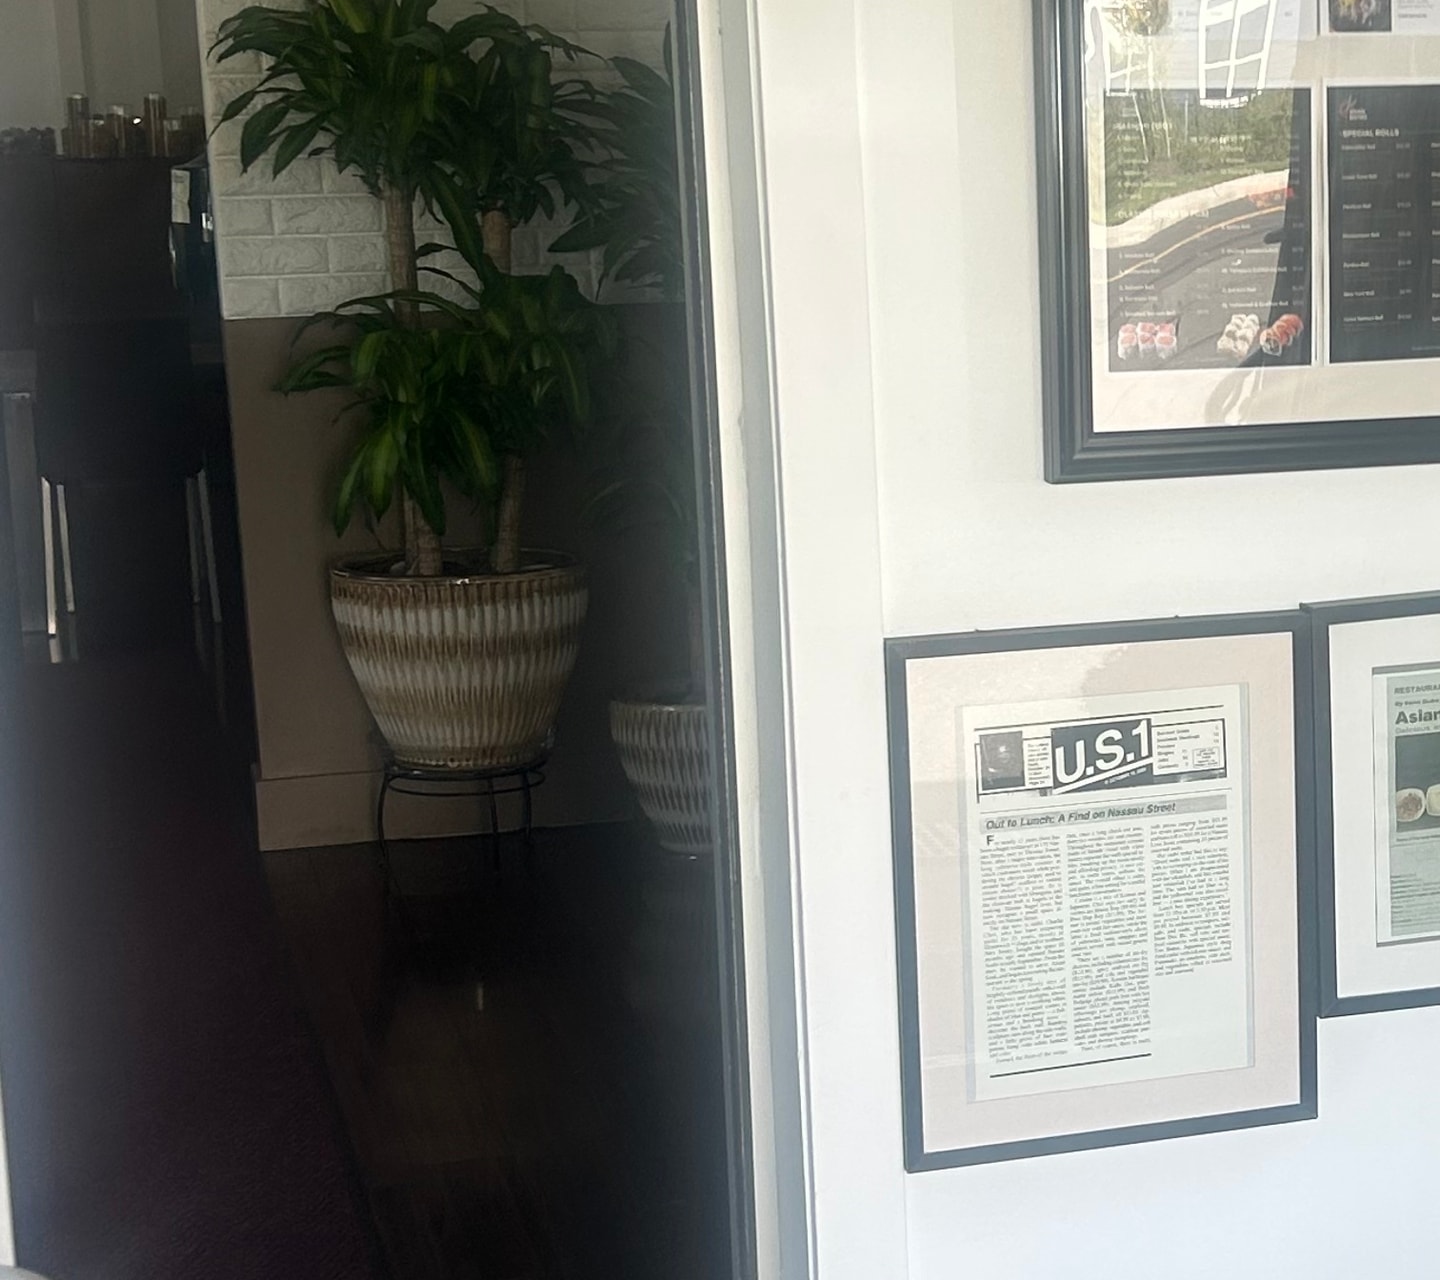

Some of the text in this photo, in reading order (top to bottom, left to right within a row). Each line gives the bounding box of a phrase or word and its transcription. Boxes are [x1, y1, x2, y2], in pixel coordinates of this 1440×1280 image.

[1342, 128, 1400, 138] SPECIAL ROLLS
[1055, 719, 1149, 784] U.S.1
[986, 802, 1177, 830] Out to Lunch: A Find on Nassau Street
